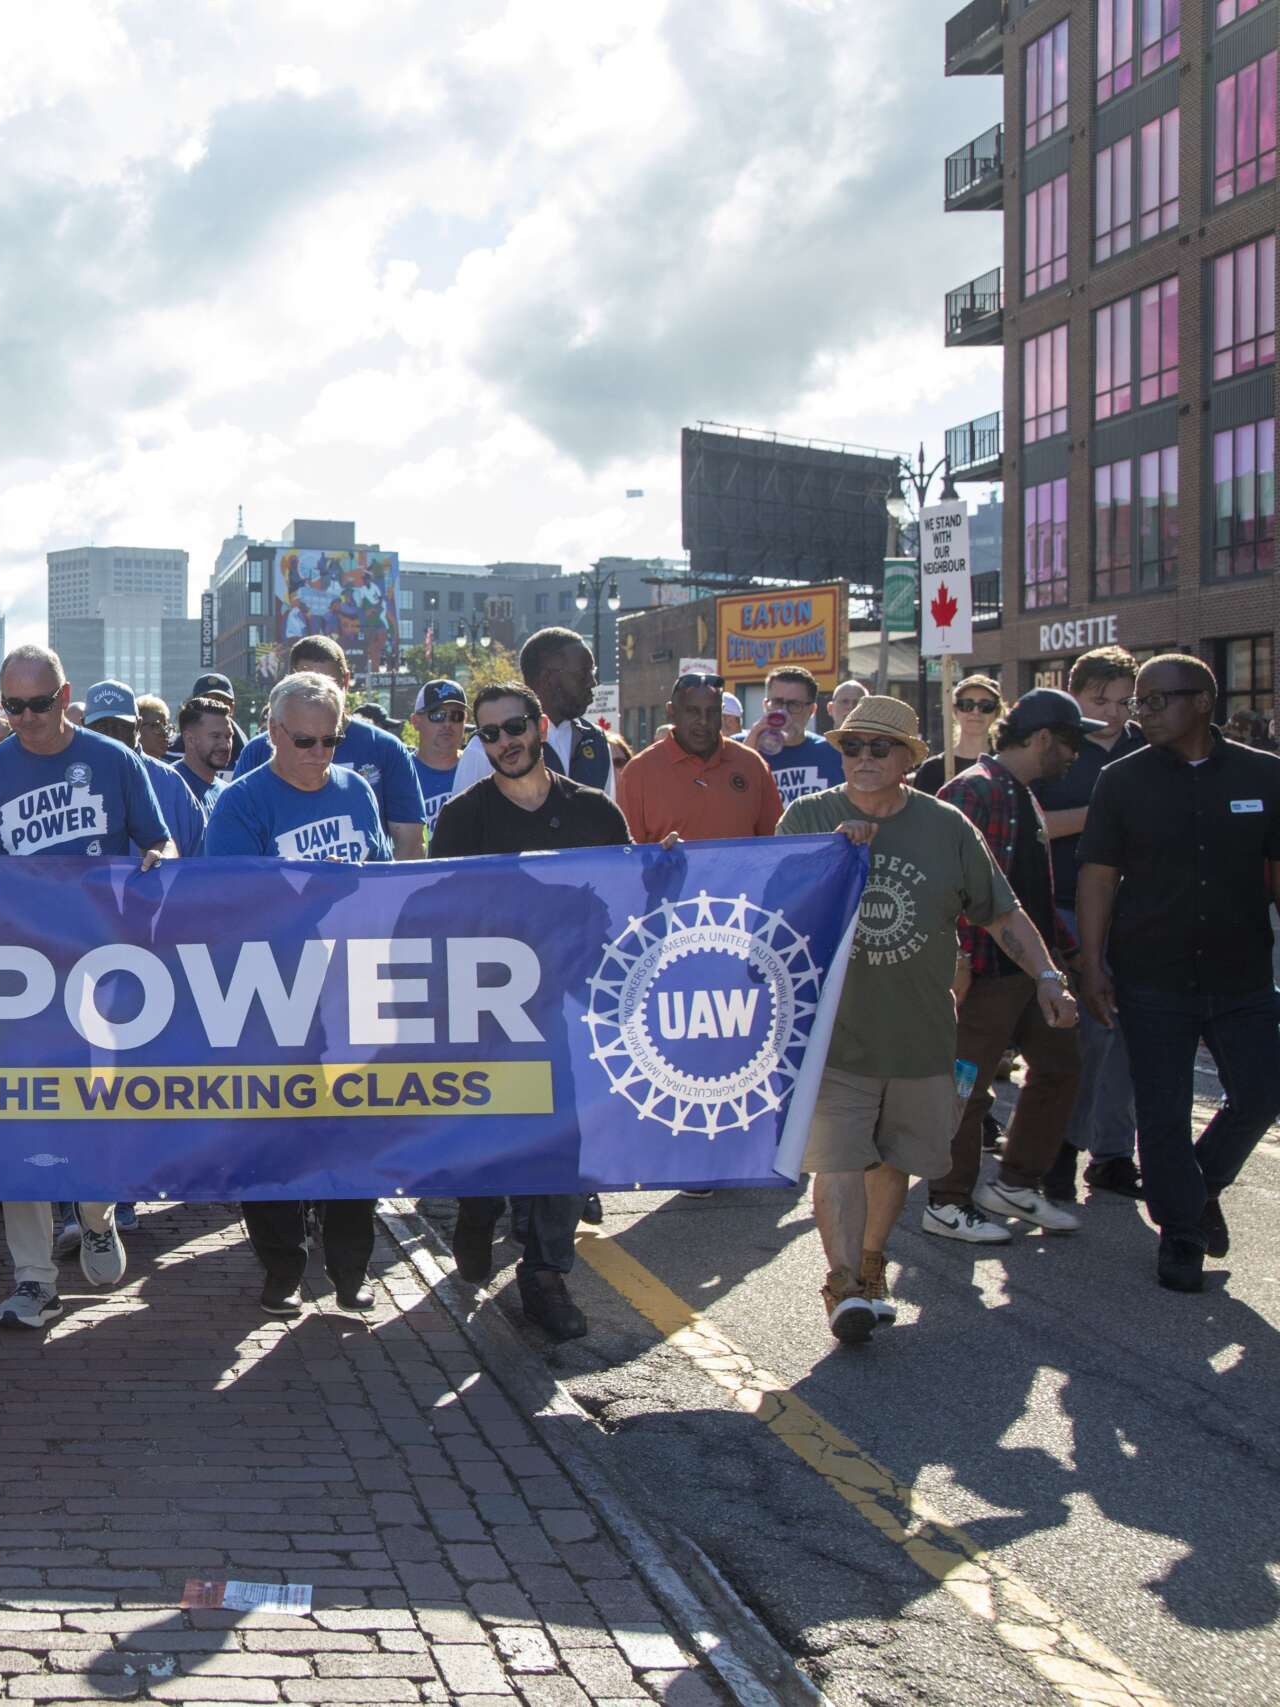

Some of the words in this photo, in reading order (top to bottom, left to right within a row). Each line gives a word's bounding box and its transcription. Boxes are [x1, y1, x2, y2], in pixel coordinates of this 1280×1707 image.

[924, 517, 934, 530] WE
[936, 514, 962, 530] STAND
[932, 530, 952, 544] WITH
[923, 558, 966, 575] NEIGHBOUR
[934, 546, 950, 559] OUR
[203, 595, 212, 644] GODFREY
[741, 599, 813, 630] EATON
[1040, 614, 1118, 652] ROSETTE
[203, 646, 212, 666] THE
[19, 784, 74, 820] UAW
[12, 806, 97, 850] POWER
[295, 819, 340, 853] UAW
[873, 854, 927, 885] PECT
[860, 902, 895, 919] UAW
[867, 931, 929, 966] WHEEL
[624, 968, 648, 1017] WORKERS
[658, 988, 759, 1039] UAW
[74, 1074, 317, 1112] WORKING
[332, 1071, 492, 1107] CLASS
